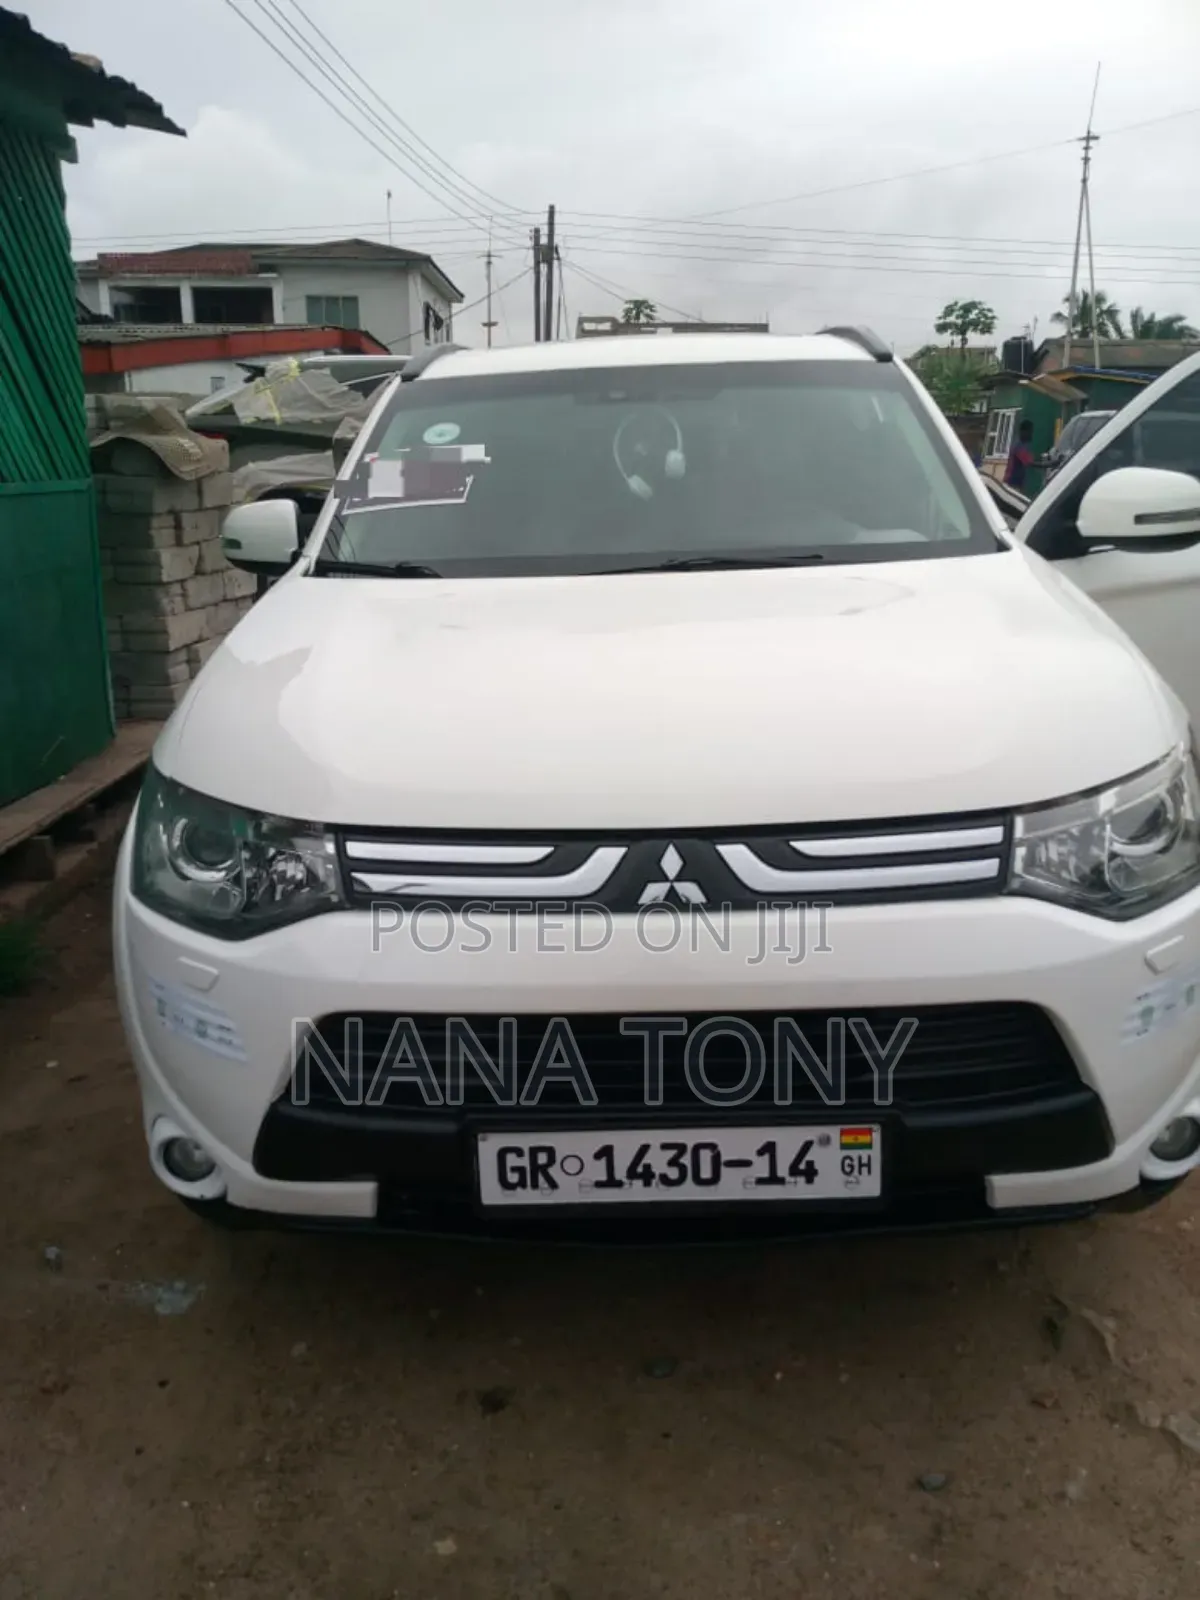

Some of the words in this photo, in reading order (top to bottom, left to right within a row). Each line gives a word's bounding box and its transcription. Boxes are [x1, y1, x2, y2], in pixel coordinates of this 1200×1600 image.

[496, 1145, 559, 1191] GR
[592, 1139, 819, 1189] 1430-14
[840, 1154, 872, 1177] GH
